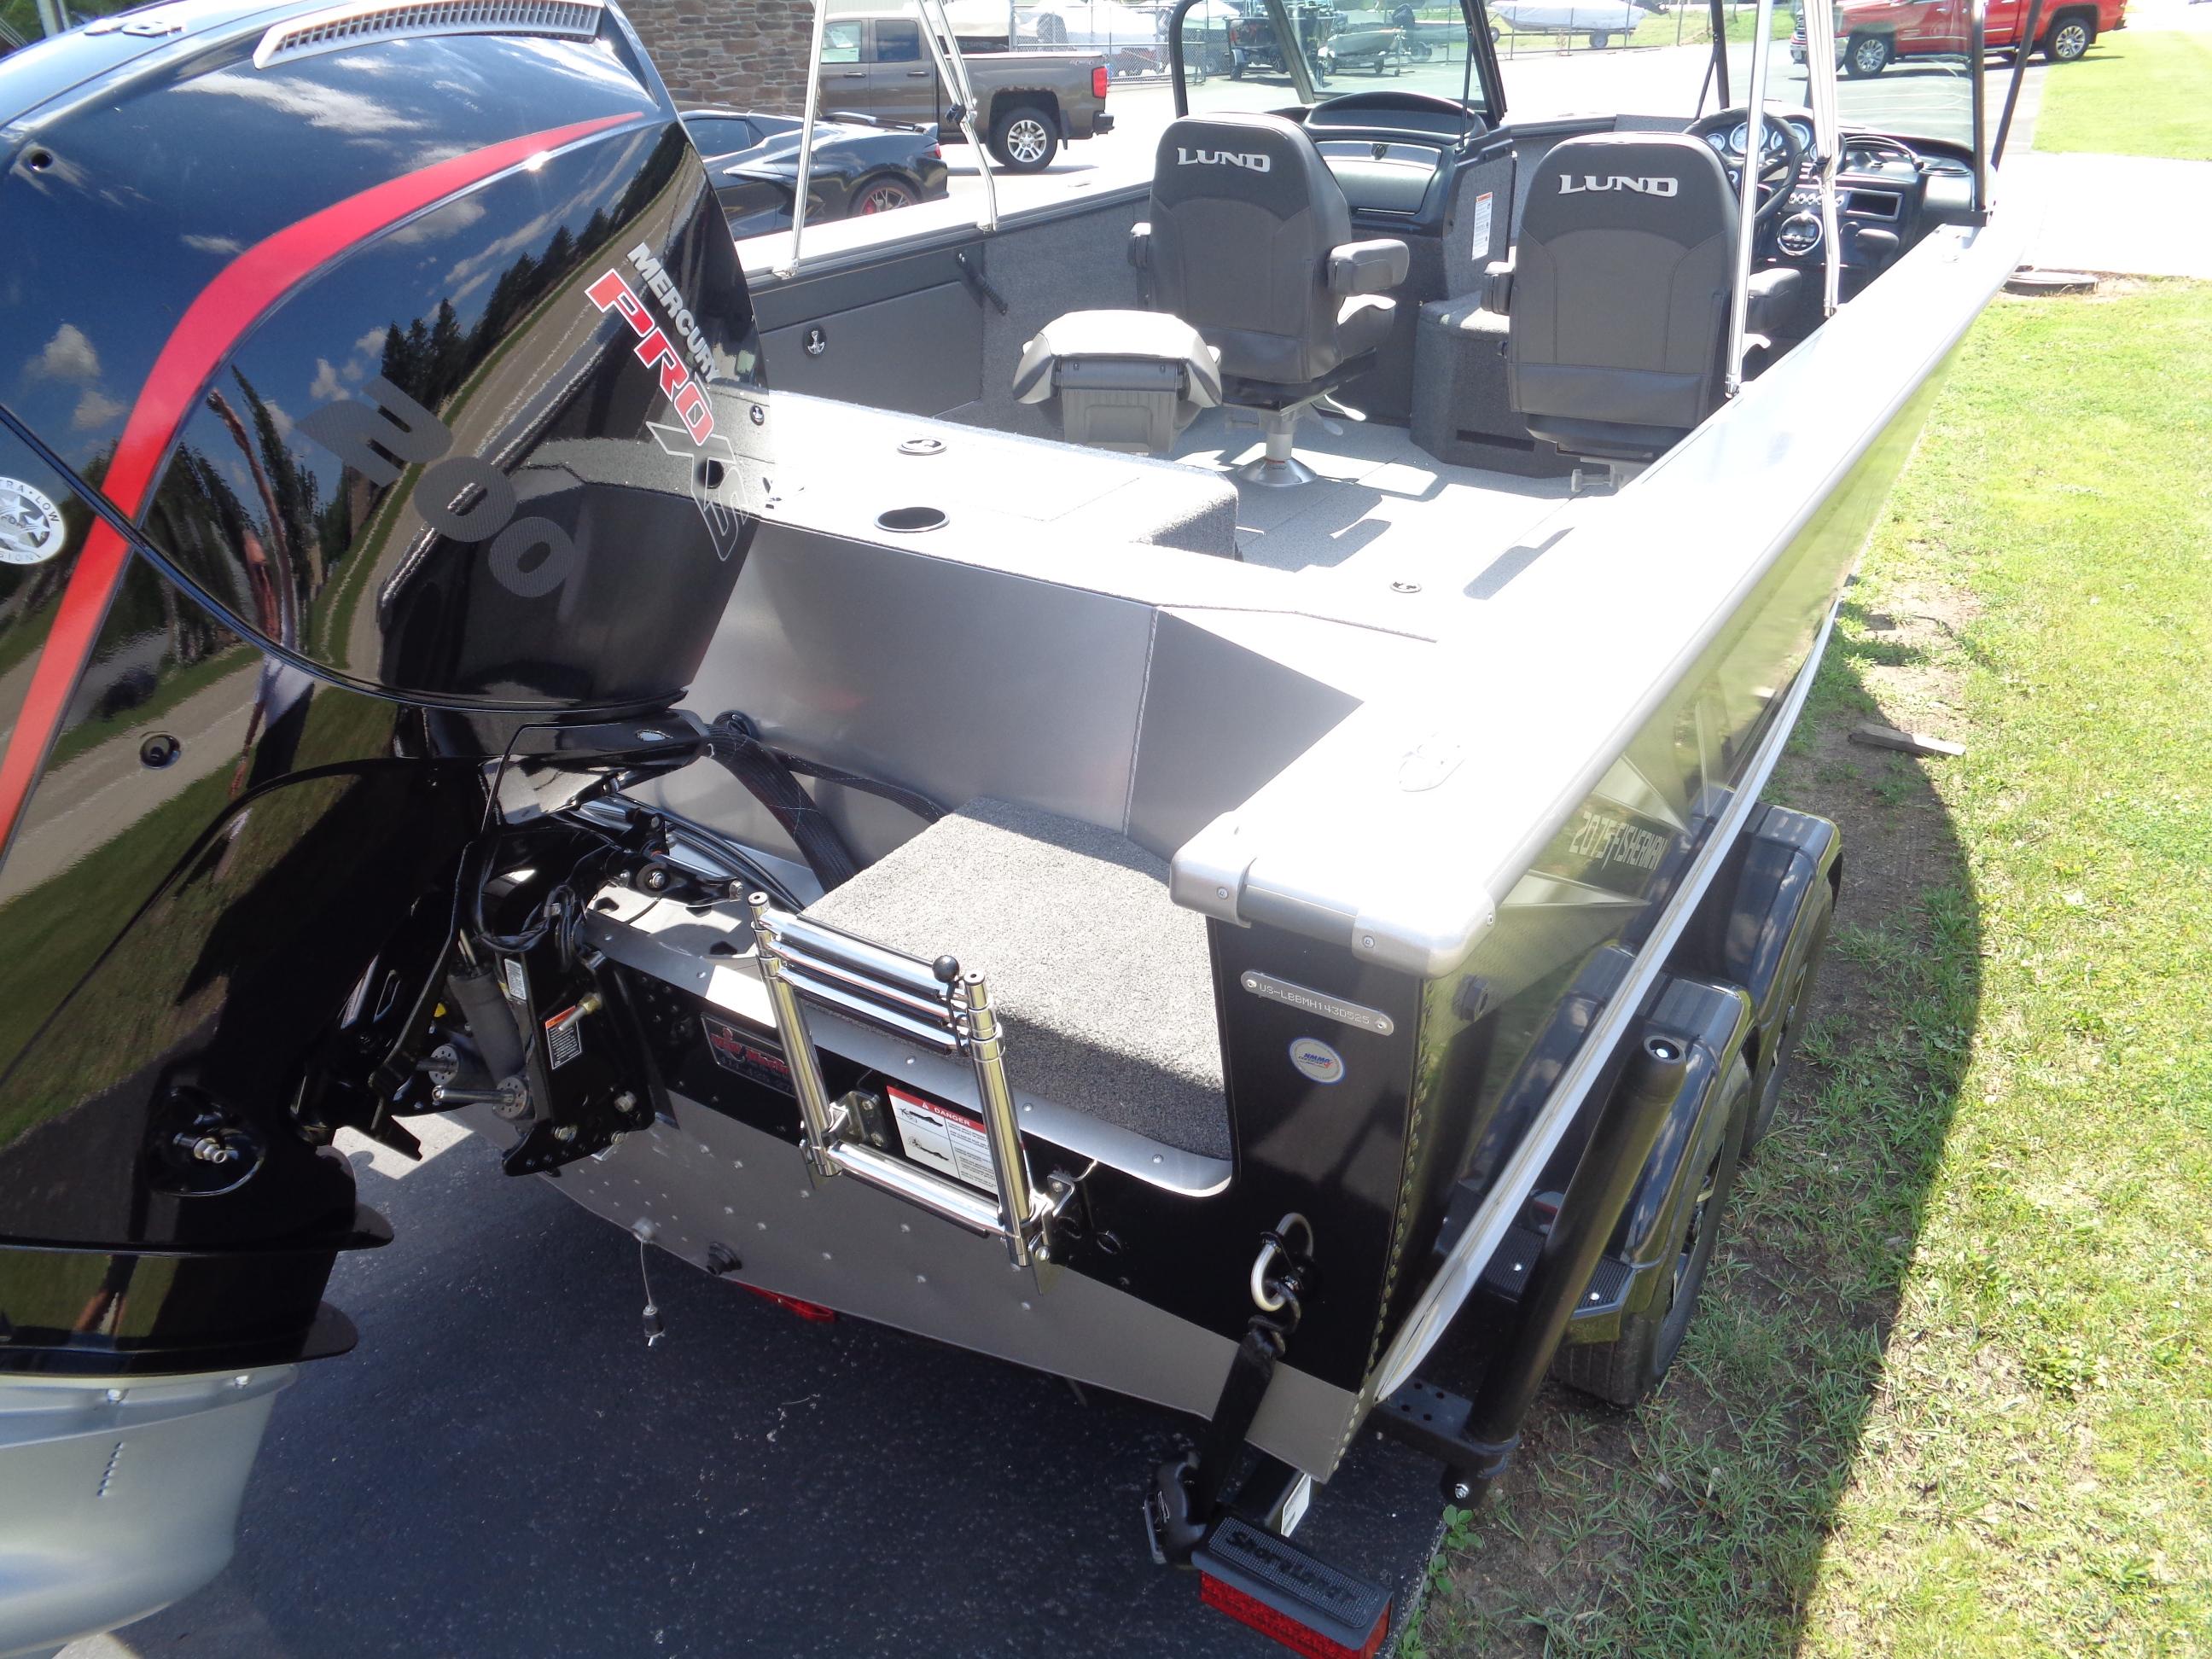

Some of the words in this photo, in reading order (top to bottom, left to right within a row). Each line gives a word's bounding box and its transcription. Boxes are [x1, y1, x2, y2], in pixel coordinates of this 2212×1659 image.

[1178, 147, 1271, 172] LUND
[1558, 174, 1679, 197] LUND
[627, 242, 720, 383] MERCURY
[585, 268, 714, 446] PRO
[295, 374, 574, 597] 200
[35, 495, 60, 522] LOW
[934, 1107, 970, 1126] DANGER
